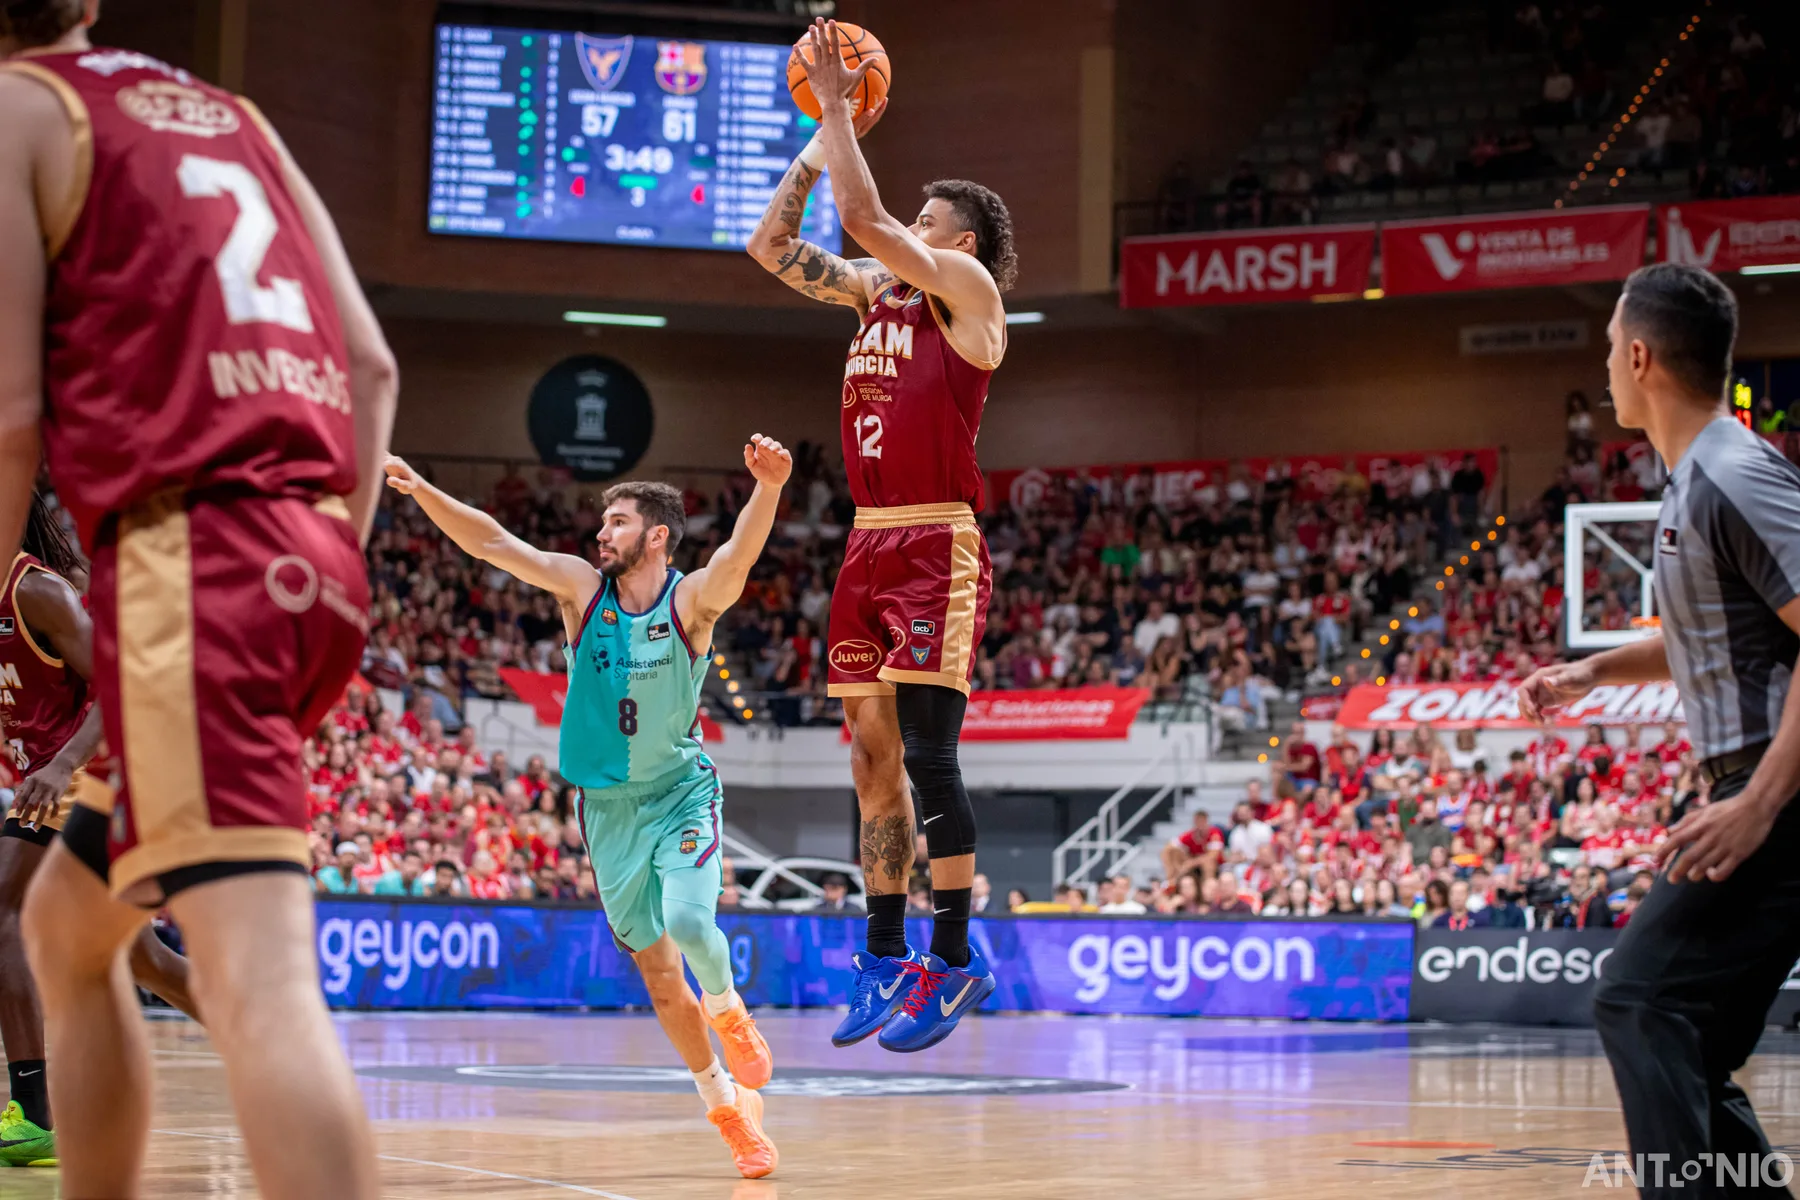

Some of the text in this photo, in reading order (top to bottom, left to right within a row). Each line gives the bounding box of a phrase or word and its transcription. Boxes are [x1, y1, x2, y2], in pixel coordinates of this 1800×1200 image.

[581, 104, 619, 137] 57
[662, 109, 697, 142] 61
[176, 154, 314, 333] 2
[1155, 241, 1337, 296] MARSH
[914, 624, 930, 633] acb
[834, 650, 875, 663] Juver
[618, 698, 638, 736] 8
[319, 917, 499, 995] geycon
[1068, 934, 1315, 1003] geycon
